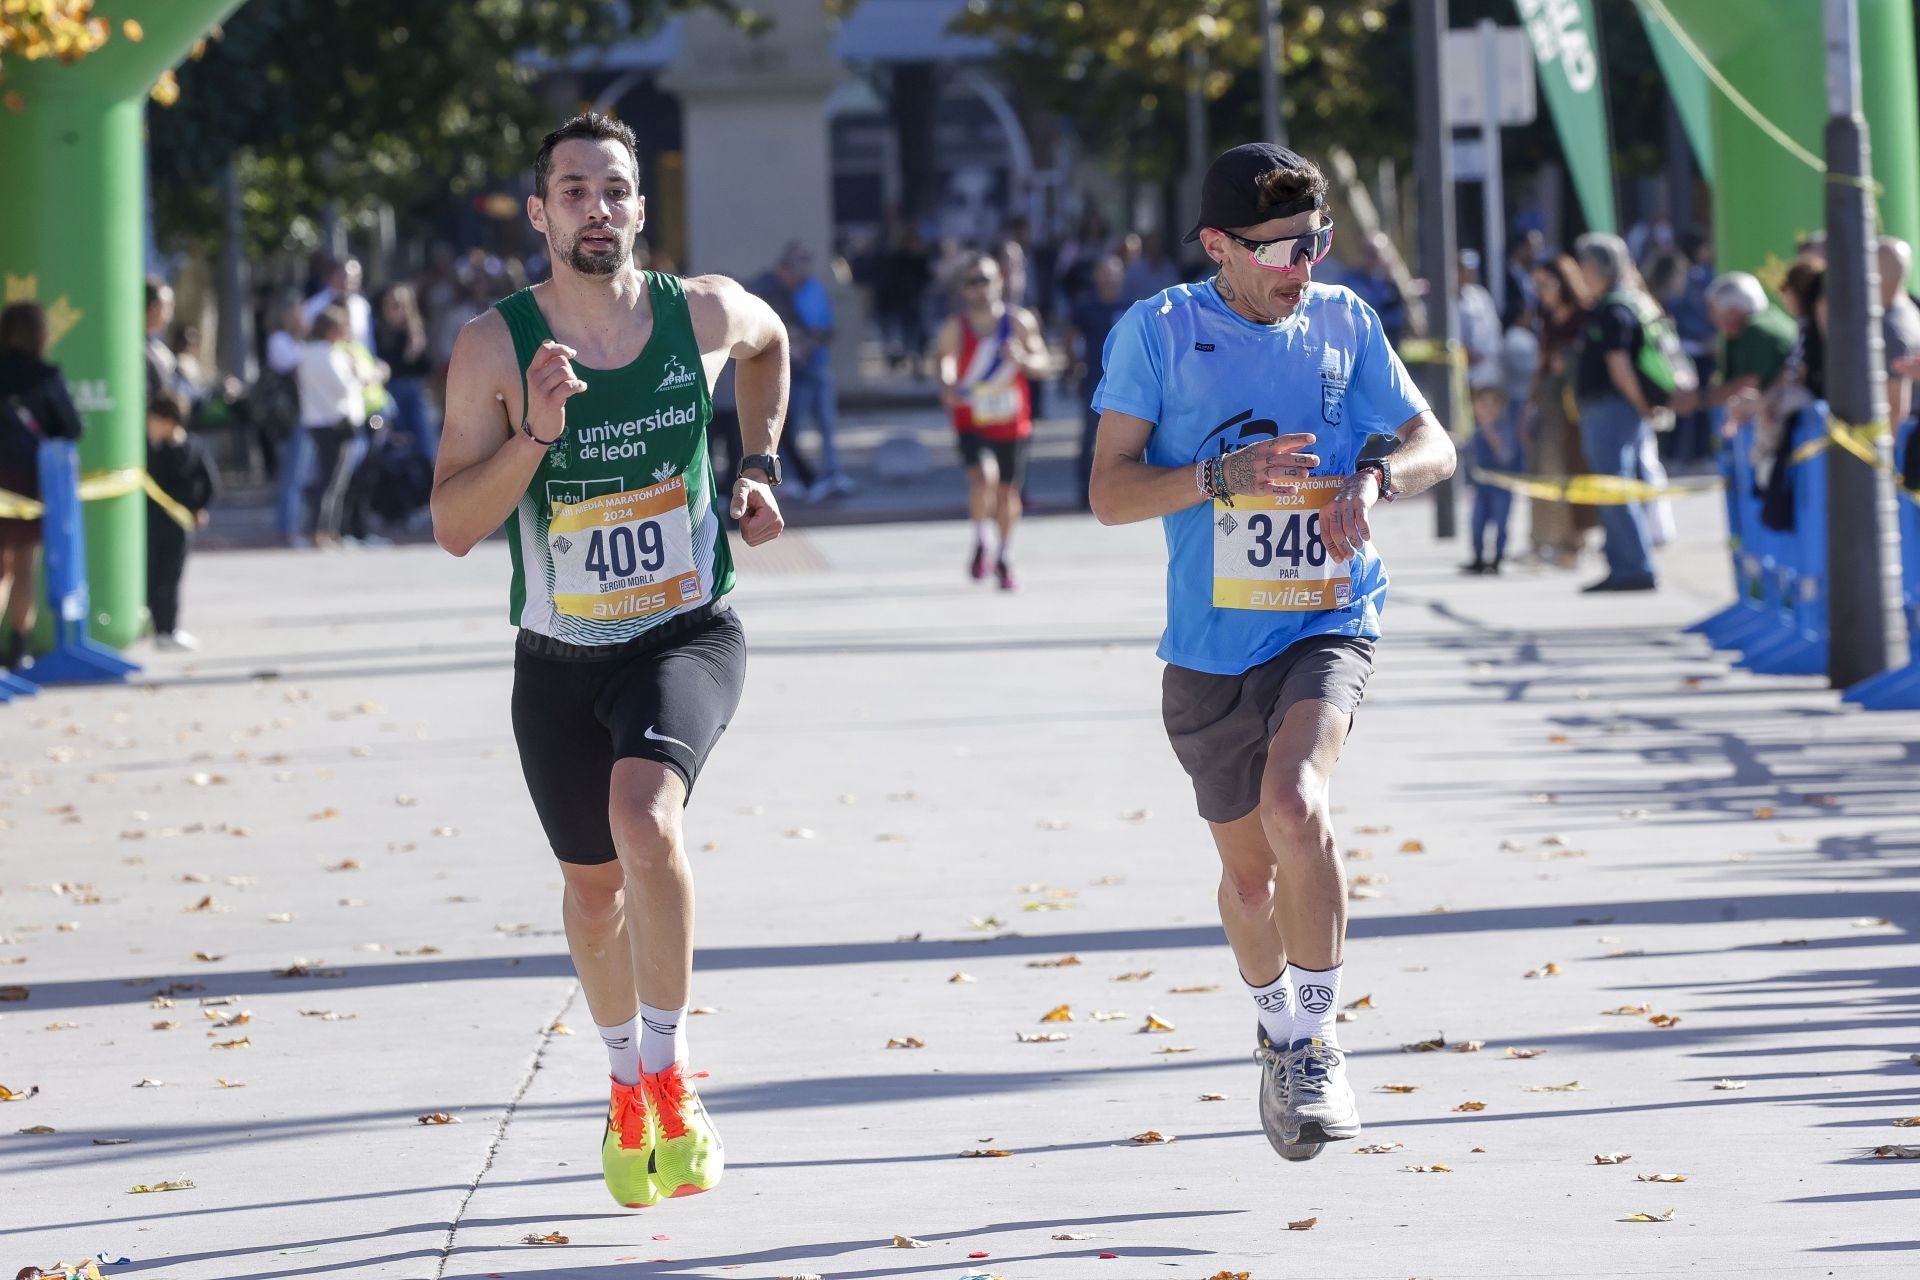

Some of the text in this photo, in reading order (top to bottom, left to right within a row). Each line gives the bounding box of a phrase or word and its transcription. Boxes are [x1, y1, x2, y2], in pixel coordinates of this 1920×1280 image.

[663, 371, 696, 386] SPRINT
[578, 401, 696, 443] universidad
[579, 439, 647, 462] de león
[576, 501, 604, 515] MEDIA
[605, 490, 653, 508] MARATÓN
[654, 478, 682, 496] AVILÉS
[1274, 495, 1306, 505] 2024
[602, 508, 634, 522] 2024
[1247, 513, 1326, 567] 348
[585, 521, 665, 582] 409
[599, 574, 655, 593] SERGIO MORLA
[1279, 567, 1299, 579] PAPÁ
[591, 591, 666, 616] avilés
[1250, 588, 1324, 606] avilés
